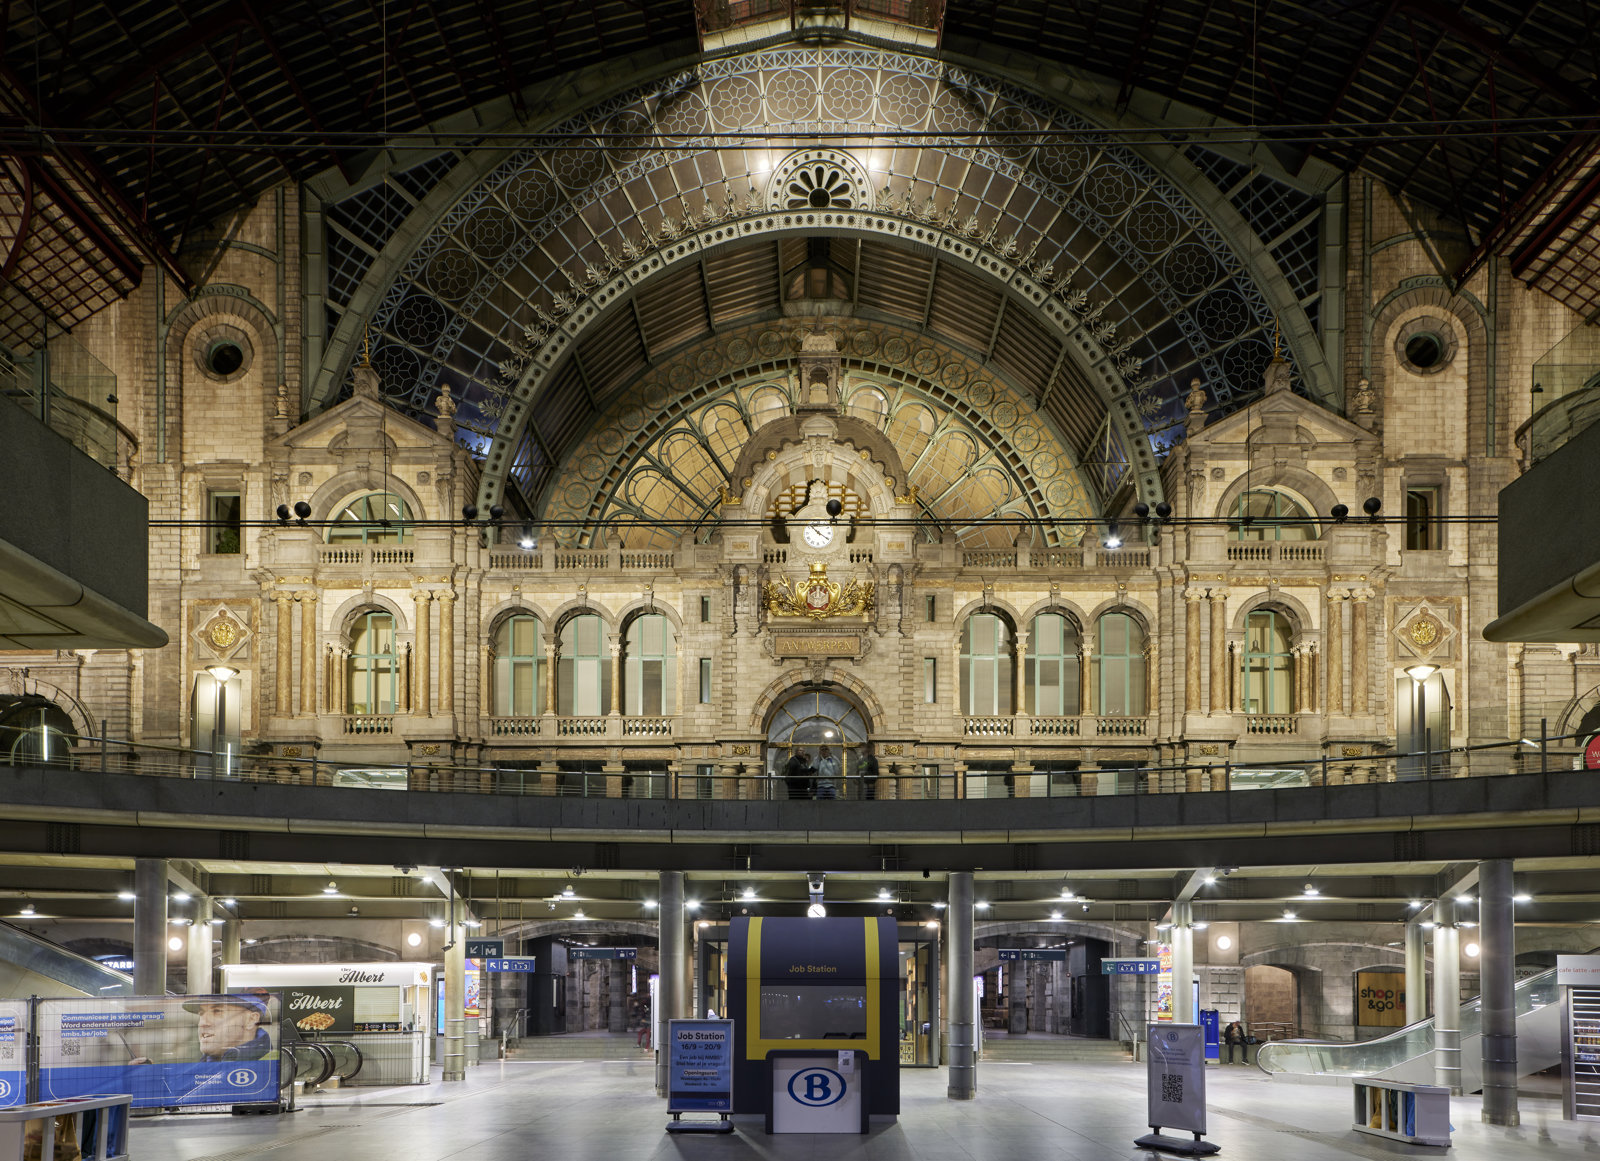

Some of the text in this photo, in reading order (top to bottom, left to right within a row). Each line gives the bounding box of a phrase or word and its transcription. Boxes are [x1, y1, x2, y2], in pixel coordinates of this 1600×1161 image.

[782, 639, 853, 651] ANTWERPEN
[102, 961, 135, 969] TARB
[789, 965, 837, 973] Job Station
[339, 970, 385, 983] Albert
[1361, 986, 1394, 1000] shop
[289, 994, 343, 1010] Albert
[1368, 999, 1394, 1012] &go
[61, 1030, 107, 1038] nmbs.be/jobs
[678, 1032, 725, 1040] Job Station
[804, 1073, 832, 1101] B
